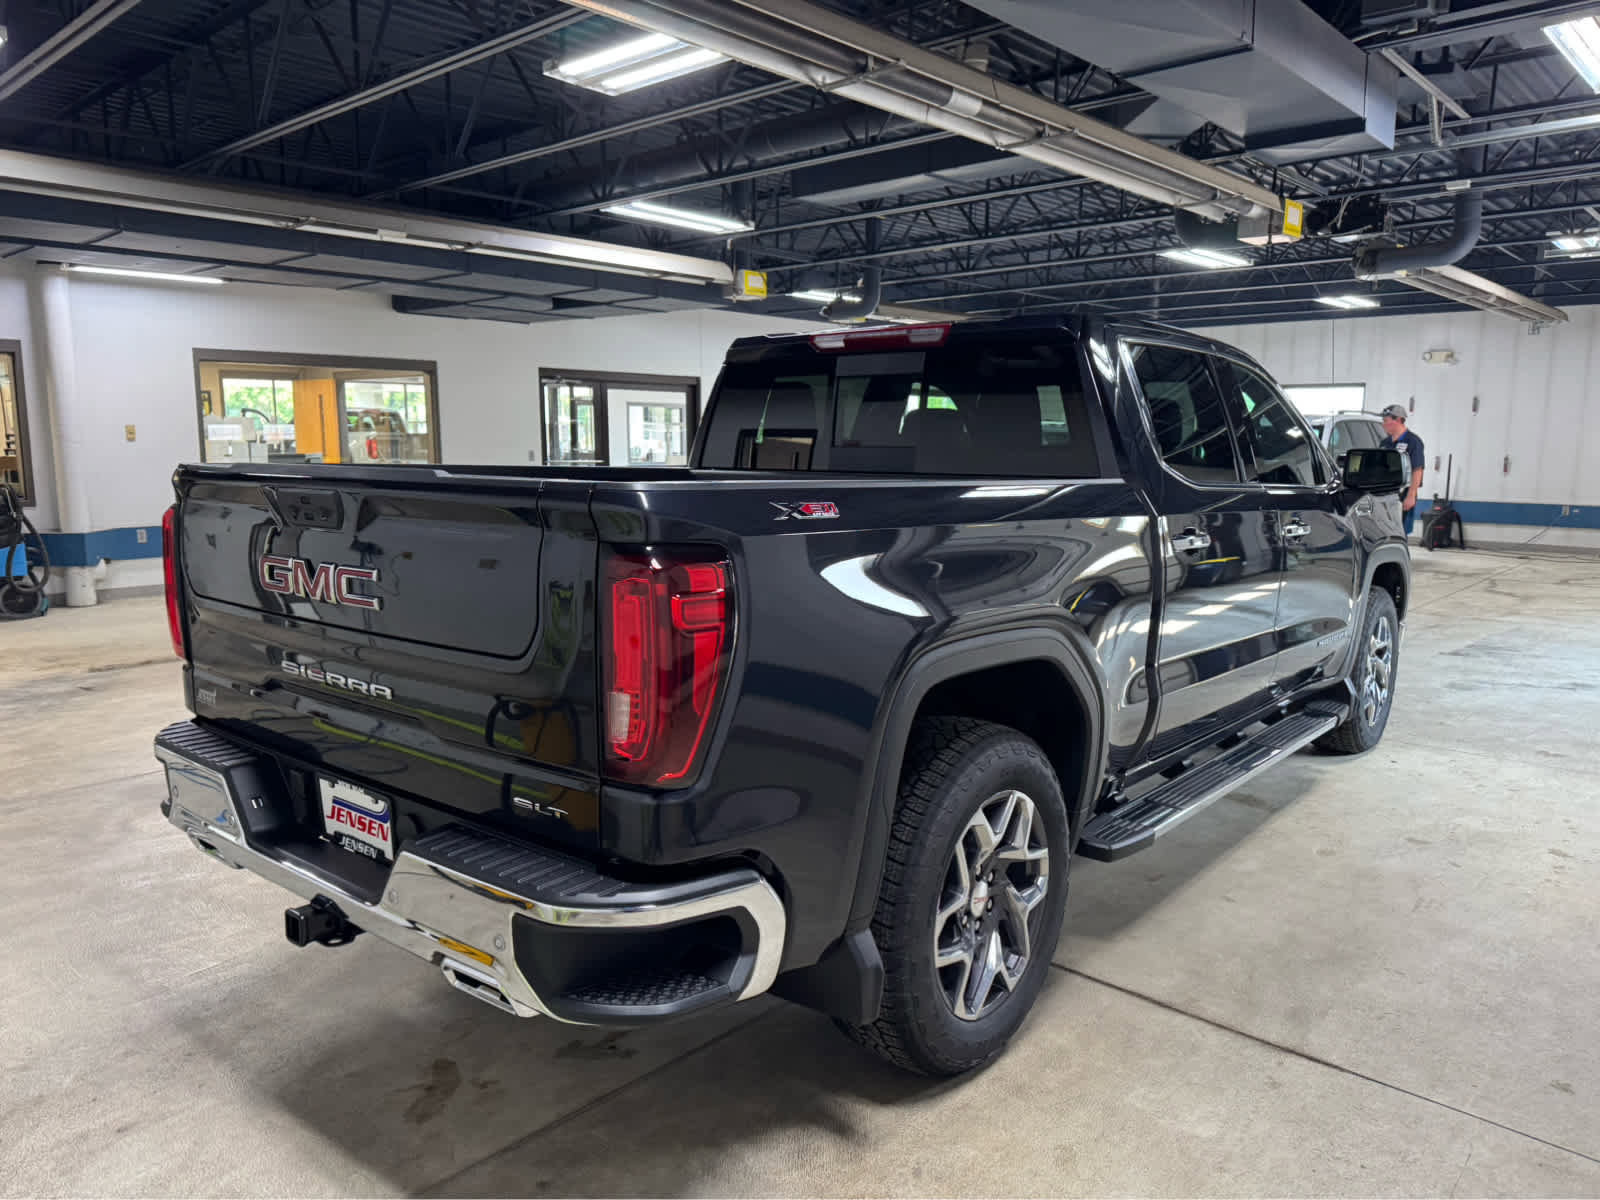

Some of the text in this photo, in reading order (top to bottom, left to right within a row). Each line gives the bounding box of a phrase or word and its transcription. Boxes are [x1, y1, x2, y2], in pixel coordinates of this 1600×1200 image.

[259, 555, 379, 611] GMC
[281, 660, 393, 700] SIERRA
[326, 805, 389, 842] JENSEN
[513, 797, 568, 818] SLT
[338, 835, 378, 859] JENSEN
